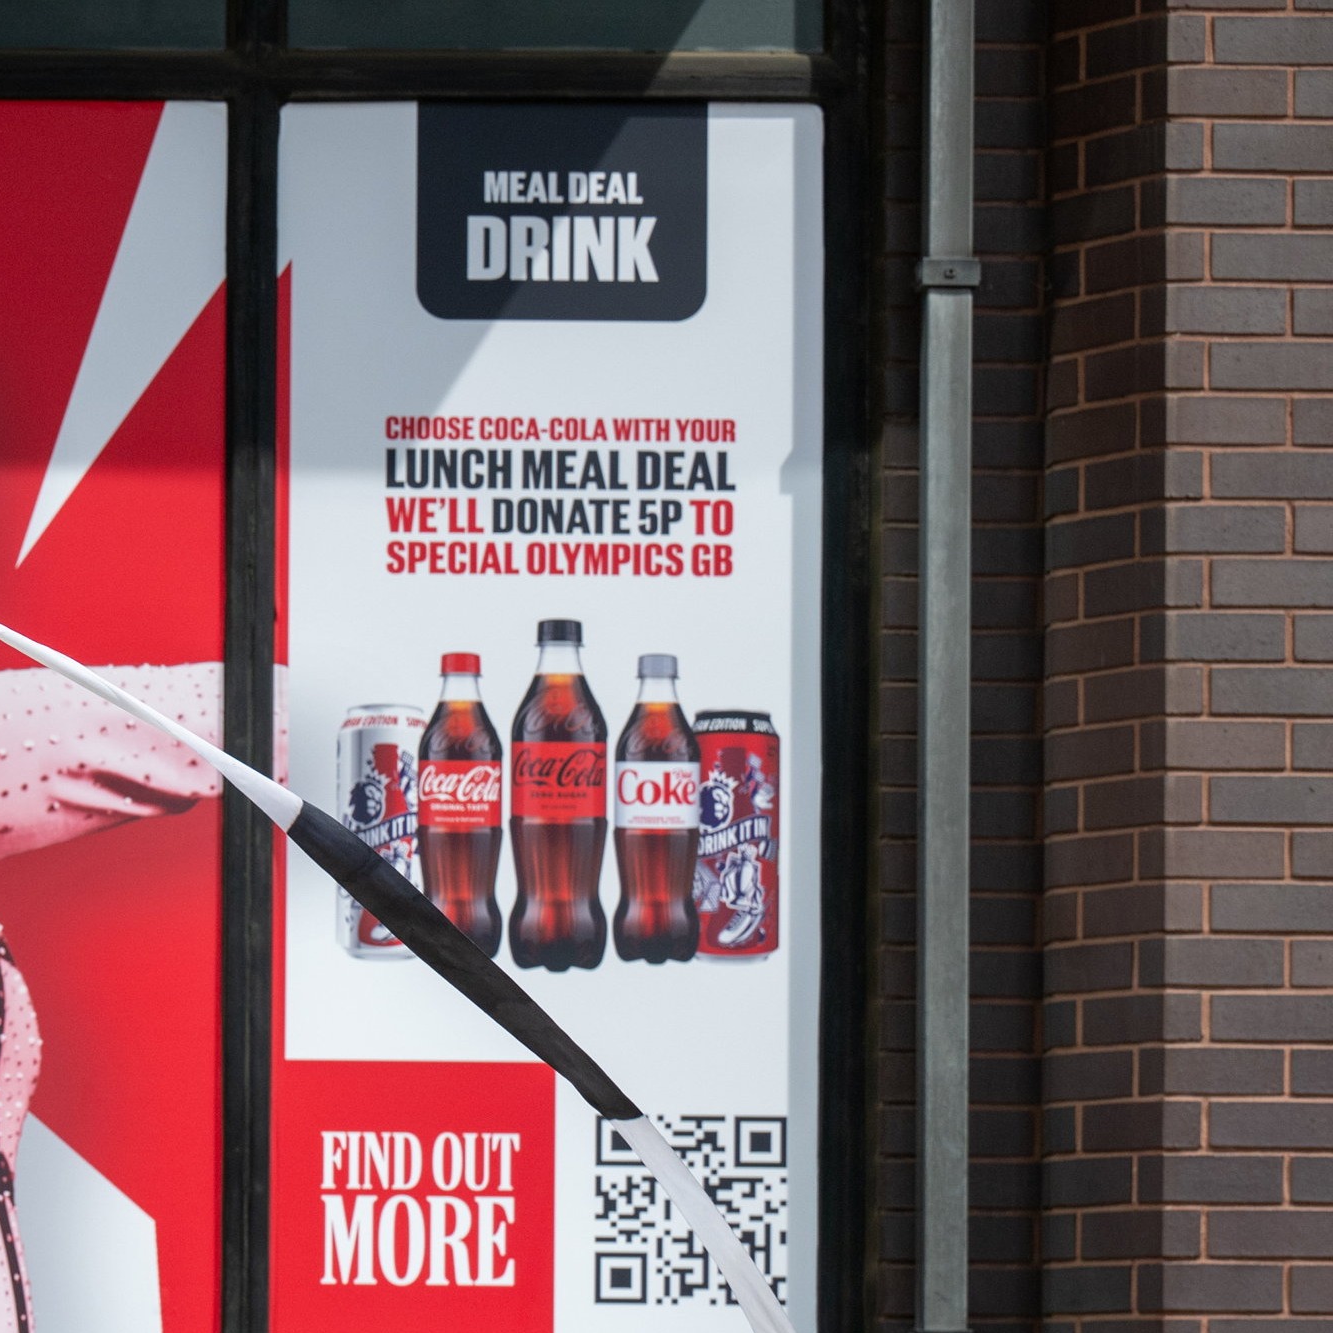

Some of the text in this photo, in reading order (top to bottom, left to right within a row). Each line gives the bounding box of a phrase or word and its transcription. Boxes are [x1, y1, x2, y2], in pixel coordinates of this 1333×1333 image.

[484, 171, 643, 204] MEAL DEAL
[466, 216, 659, 282] DRINK
[385, 416, 736, 443] CHOOSE COCA-COLA WITH YOUR
[385, 448, 736, 492] LUNCH MEAL DEAL
[386, 497, 734, 536] WE'LL DONATE 5P TO
[387, 541, 734, 577] SPECIAL OLYMPICS GB
[419, 764, 501, 802] Coca-Cola
[514, 748, 604, 787] Coca-Cola
[617, 769, 696, 806] Coke
[739, 819, 753, 842] IT
[754, 816, 768, 838] IN
[320, 1130, 520, 1191] FIND OUT
[320, 1194, 515, 1286] MORE
